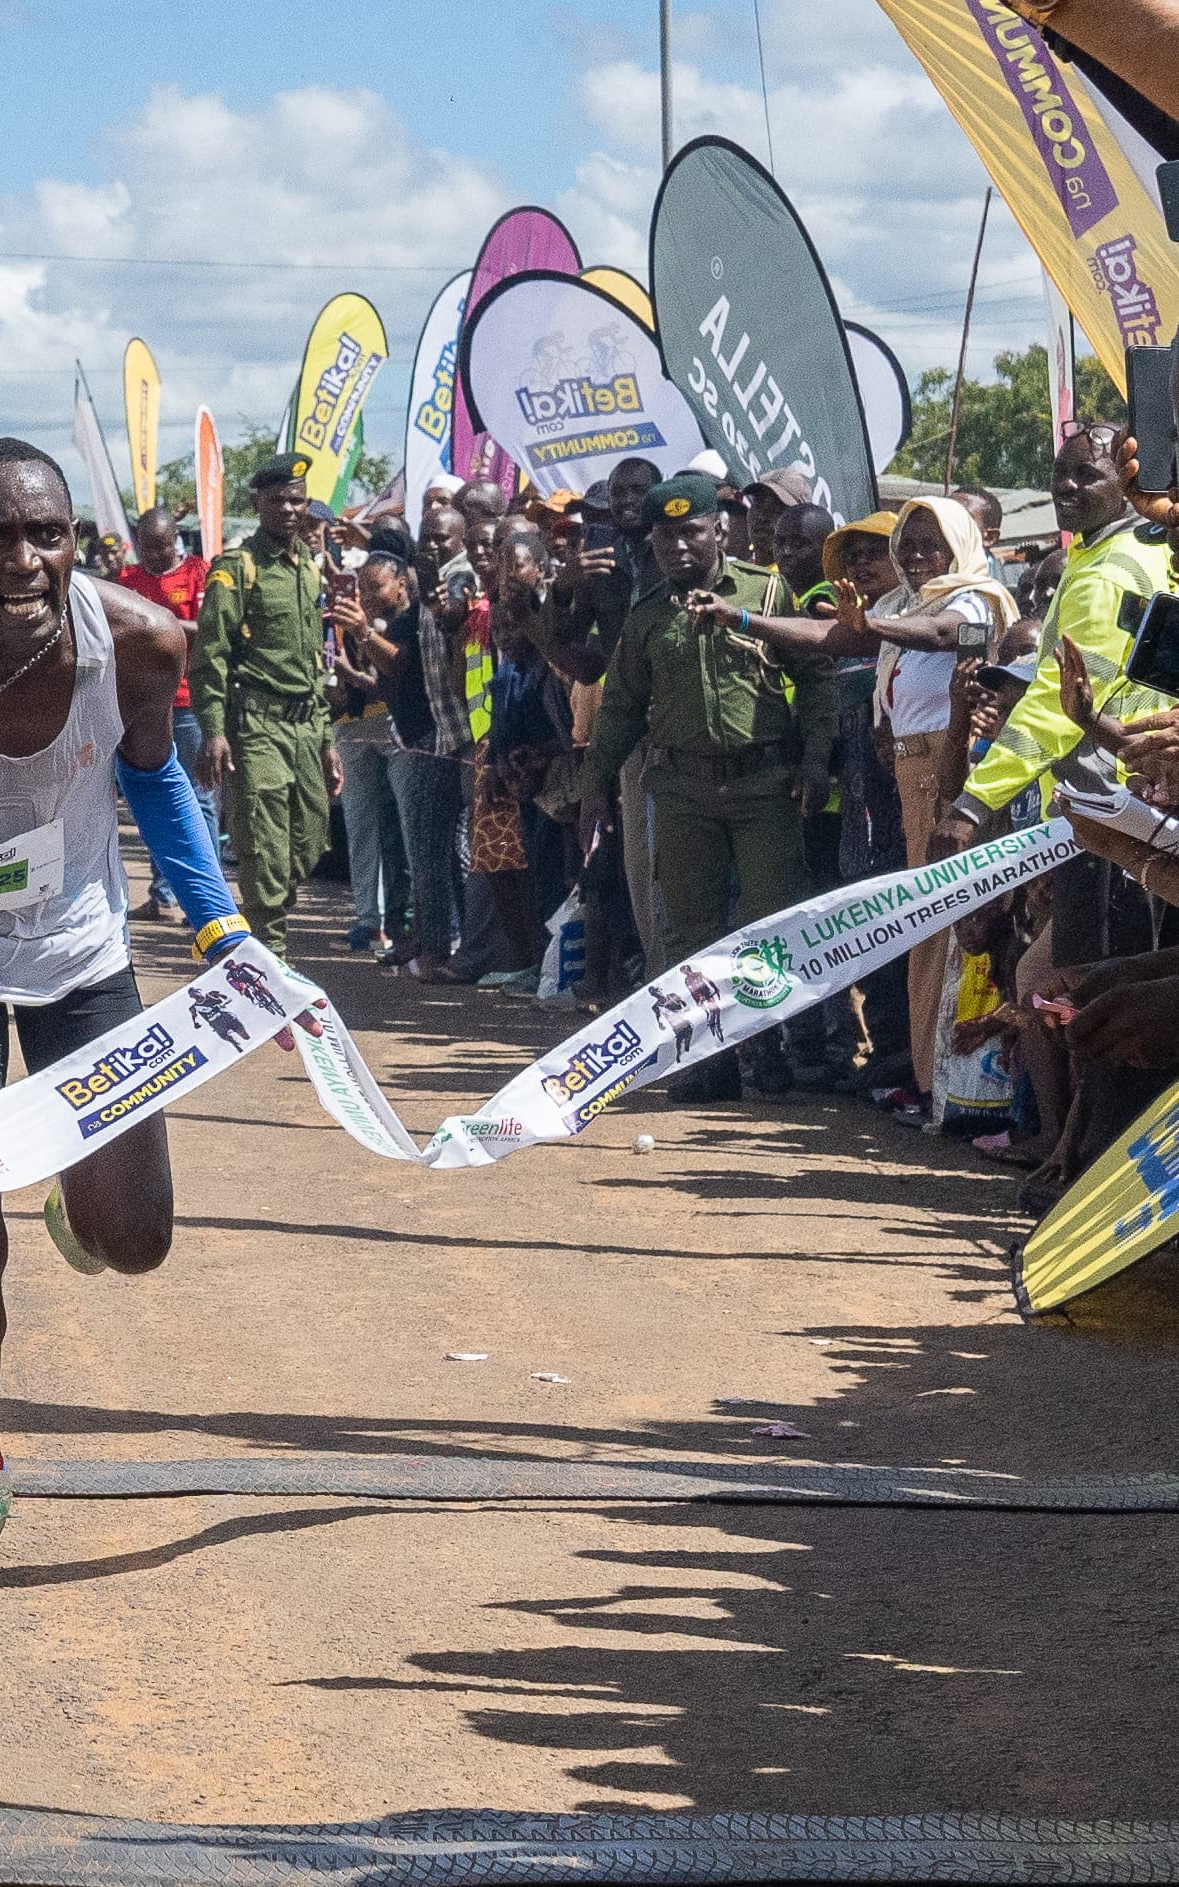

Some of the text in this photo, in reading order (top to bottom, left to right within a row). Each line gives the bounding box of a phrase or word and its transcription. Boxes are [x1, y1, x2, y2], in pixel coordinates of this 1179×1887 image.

[302, 332, 362, 449] Betika!
[799, 838, 1083, 982] 10 MILLION TREES MARATHON
[801, 826, 1052, 949] LUKENYA UNIVERSITY
[58, 1024, 175, 1109] Betika!
[87, 1052, 197, 1132] na COMMUNITY
[147, 1045, 176, 1069] com
[542, 1022, 640, 1107] Betika!
[620, 1047, 644, 1066] com
